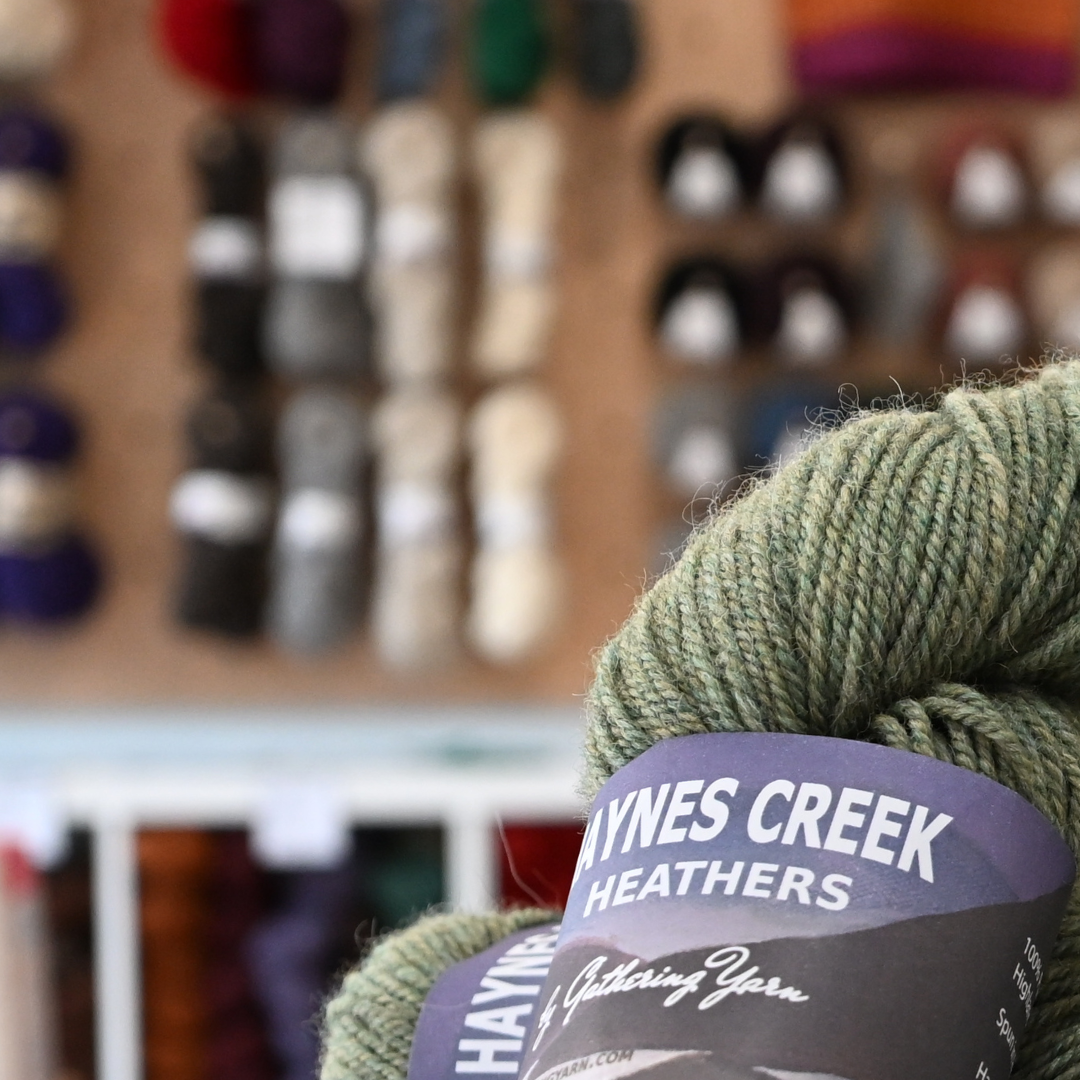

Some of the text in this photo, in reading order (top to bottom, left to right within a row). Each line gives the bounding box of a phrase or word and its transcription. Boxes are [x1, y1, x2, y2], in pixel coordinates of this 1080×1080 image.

[746, 778, 953, 884] CREEK
[583, 860, 853, 918] HEATHERS
[562, 956, 708, 1026] Gathering
[698, 946, 811, 1010] Yarn
